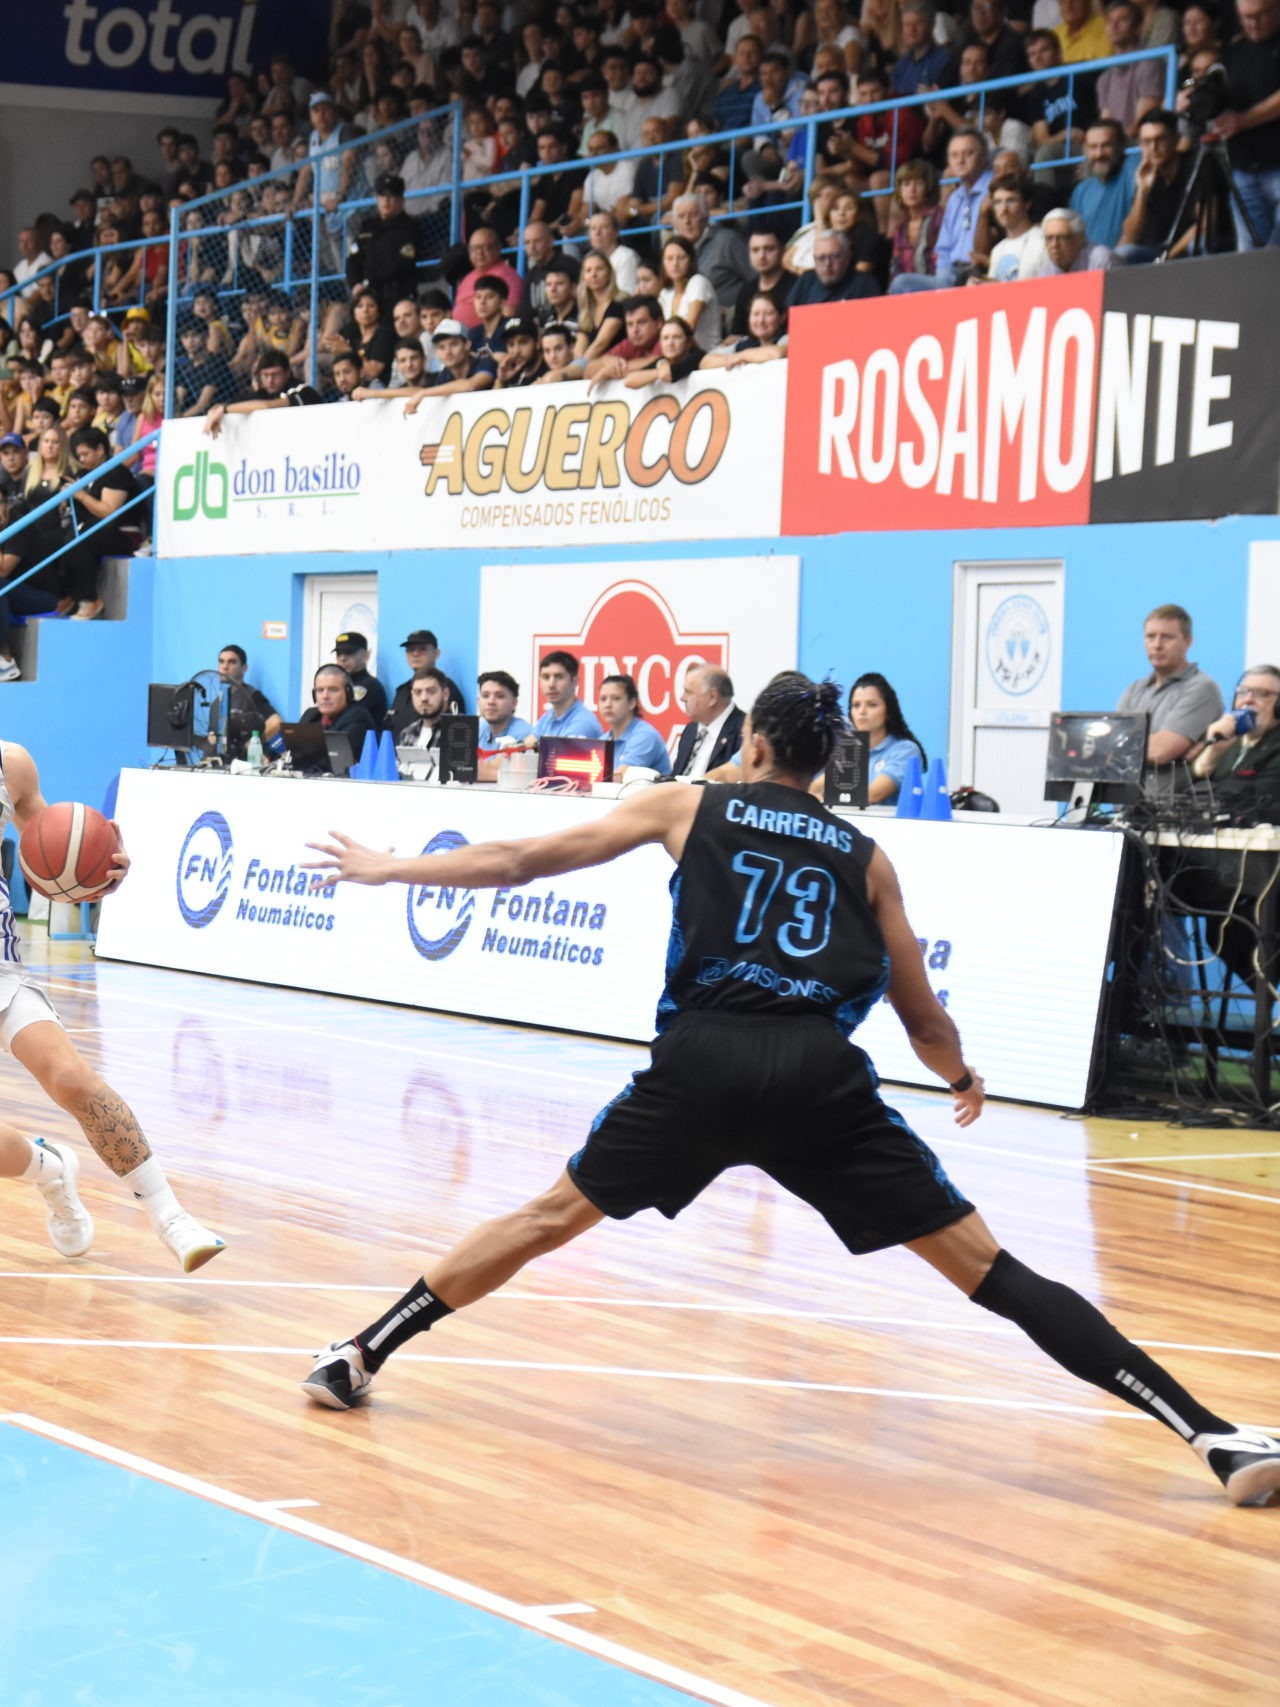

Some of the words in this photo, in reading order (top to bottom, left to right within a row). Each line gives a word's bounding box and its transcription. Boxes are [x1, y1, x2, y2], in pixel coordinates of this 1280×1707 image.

[64, 0, 258, 75] total
[818, 306, 1239, 503] ROSAMONTE
[422, 388, 731, 496] AGUERCO
[233, 459, 275, 496] don
[285, 452, 361, 493] basilio
[461, 502, 575, 528] COMPENSADOS
[579, 493, 672, 525] FENÓLICOS
[725, 799, 853, 853] CARRERAS
[184, 855, 217, 883] FN
[243, 859, 338, 899] Fontana
[236, 898, 335, 931] Neumáticos
[491, 887, 607, 930] Fontana
[732, 850, 836, 957] 73
[482, 927, 604, 966] Neumáticos
[728, 961, 837, 1001] MISIONES
